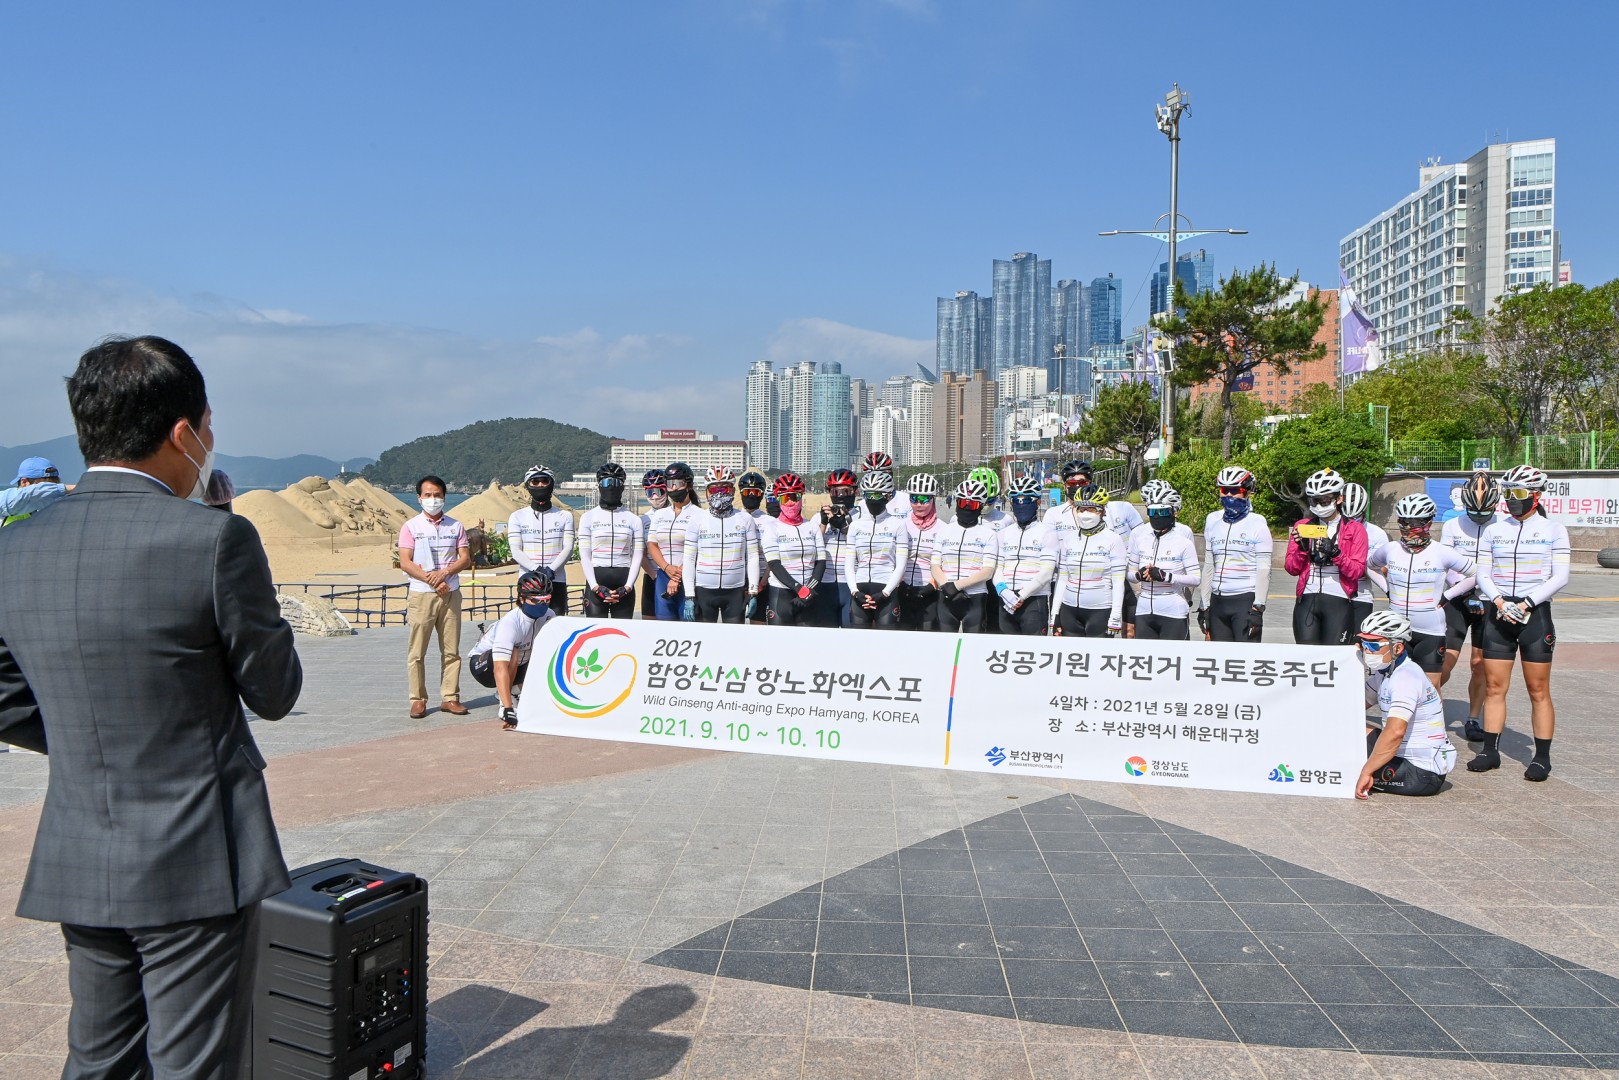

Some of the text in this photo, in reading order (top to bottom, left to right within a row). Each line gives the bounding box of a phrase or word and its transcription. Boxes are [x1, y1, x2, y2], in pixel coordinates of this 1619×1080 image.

[1547, 481, 1570, 496] 위해
[1569, 499, 1618, 514] 띄우기와
[653, 639, 701, 657] 2021
[986, 650, 1338, 687] 성공기원 자전거 국토종주단
[647, 661, 922, 702] 함양산삼항노화엑스포
[644, 695, 919, 723] Wild Ginseng Anti-aging Expo Hamyang, KOREA
[1050, 696, 1088, 711] 4일차
[1103, 699, 1157, 715] 2021년
[1164, 703, 1187, 716] 5월
[1194, 704, 1228, 719] 28일
[1235, 704, 1260, 720] (금)
[640, 716, 693, 737] 2021.
[701, 721, 718, 740] 9.
[727, 723, 749, 741] 10
[778, 727, 805, 746] 10.
[816, 730, 840, 748] 10
[1102, 722, 1176, 739] 부산광역시
[1182, 726, 1258, 744] 해운대구청
[1010, 751, 1063, 763] 부산광역시
[1151, 760, 1189, 771] 경상남도
[1151, 770, 1189, 779] GYEONGNAM
[1300, 769, 1341, 784] 함양군
